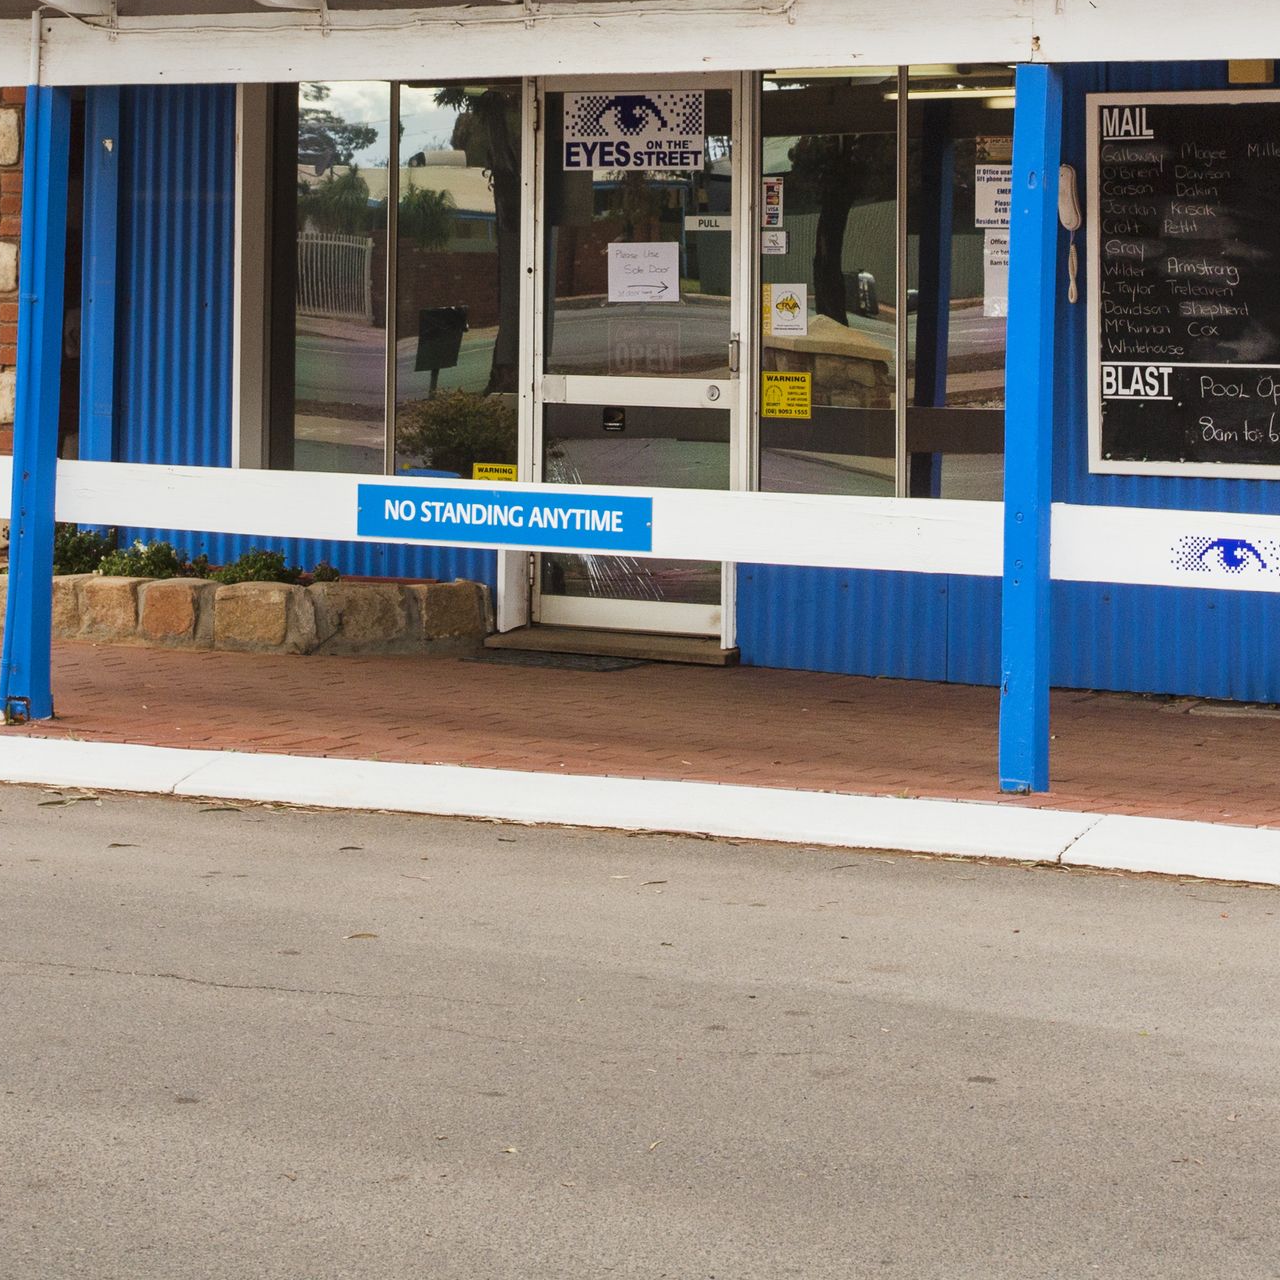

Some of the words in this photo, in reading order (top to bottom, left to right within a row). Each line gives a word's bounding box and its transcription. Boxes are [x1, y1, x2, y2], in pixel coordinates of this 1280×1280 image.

[1103, 107, 1154, 136] MAIL
[565, 141, 631, 167] EYES
[646, 140, 663, 150] ON
[633, 151, 702, 166] STREET
[1101, 144, 1163, 172] Galloway
[1103, 167, 1160, 180] O'Brien
[1103, 183, 1153, 196] Carson
[1176, 183, 1218, 197] Dakin
[1103, 199, 1157, 216] Jordan
[697, 219, 720, 228] PULL
[615, 249, 638, 259] Please
[1105, 240, 1145, 261] Gray
[648, 264, 670, 274] Door
[1167, 256, 1240, 286] Armstrong
[1102, 283, 1111, 295] L
[1118, 284, 1155, 302] Taylor
[1165, 280, 1234, 297] Treleaven
[1104, 300, 1169, 315] Davidson
[1179, 301, 1249, 319] Shepherd
[1187, 322, 1220, 337] Cox
[1108, 338, 1184, 355] Whitehouse
[1103, 366, 1173, 396] BLAST
[1199, 416, 1238, 442] 8am
[384, 499, 416, 520] NO
[421, 501, 524, 527] STANDING
[528, 506, 624, 533] ANYTIME
